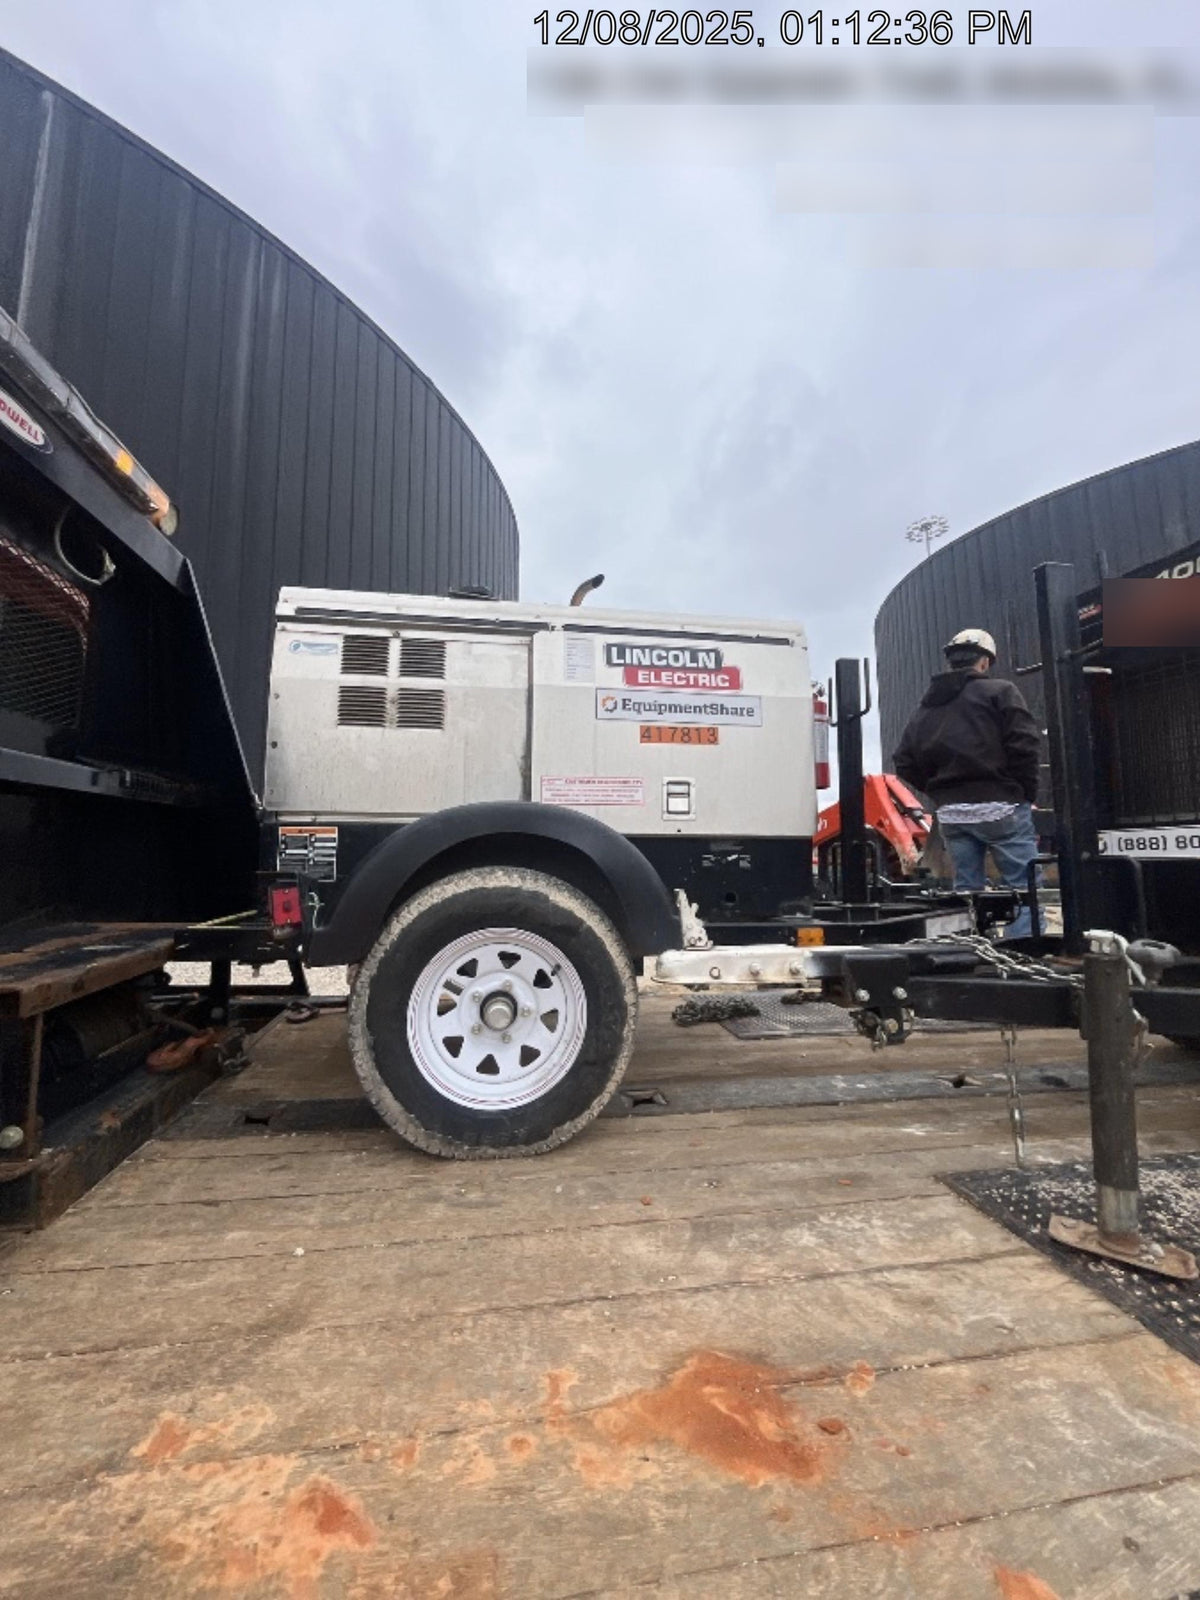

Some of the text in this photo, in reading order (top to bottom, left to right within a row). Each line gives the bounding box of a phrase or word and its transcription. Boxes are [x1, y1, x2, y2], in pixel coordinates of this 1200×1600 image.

[611, 646, 716, 669] LINCOLN
[637, 670, 730, 688] ELECTRIC
[621, 697, 756, 718] EquipmentShare
[640, 726, 719, 744] 417813
[1118, 834, 1167, 852] (888)
